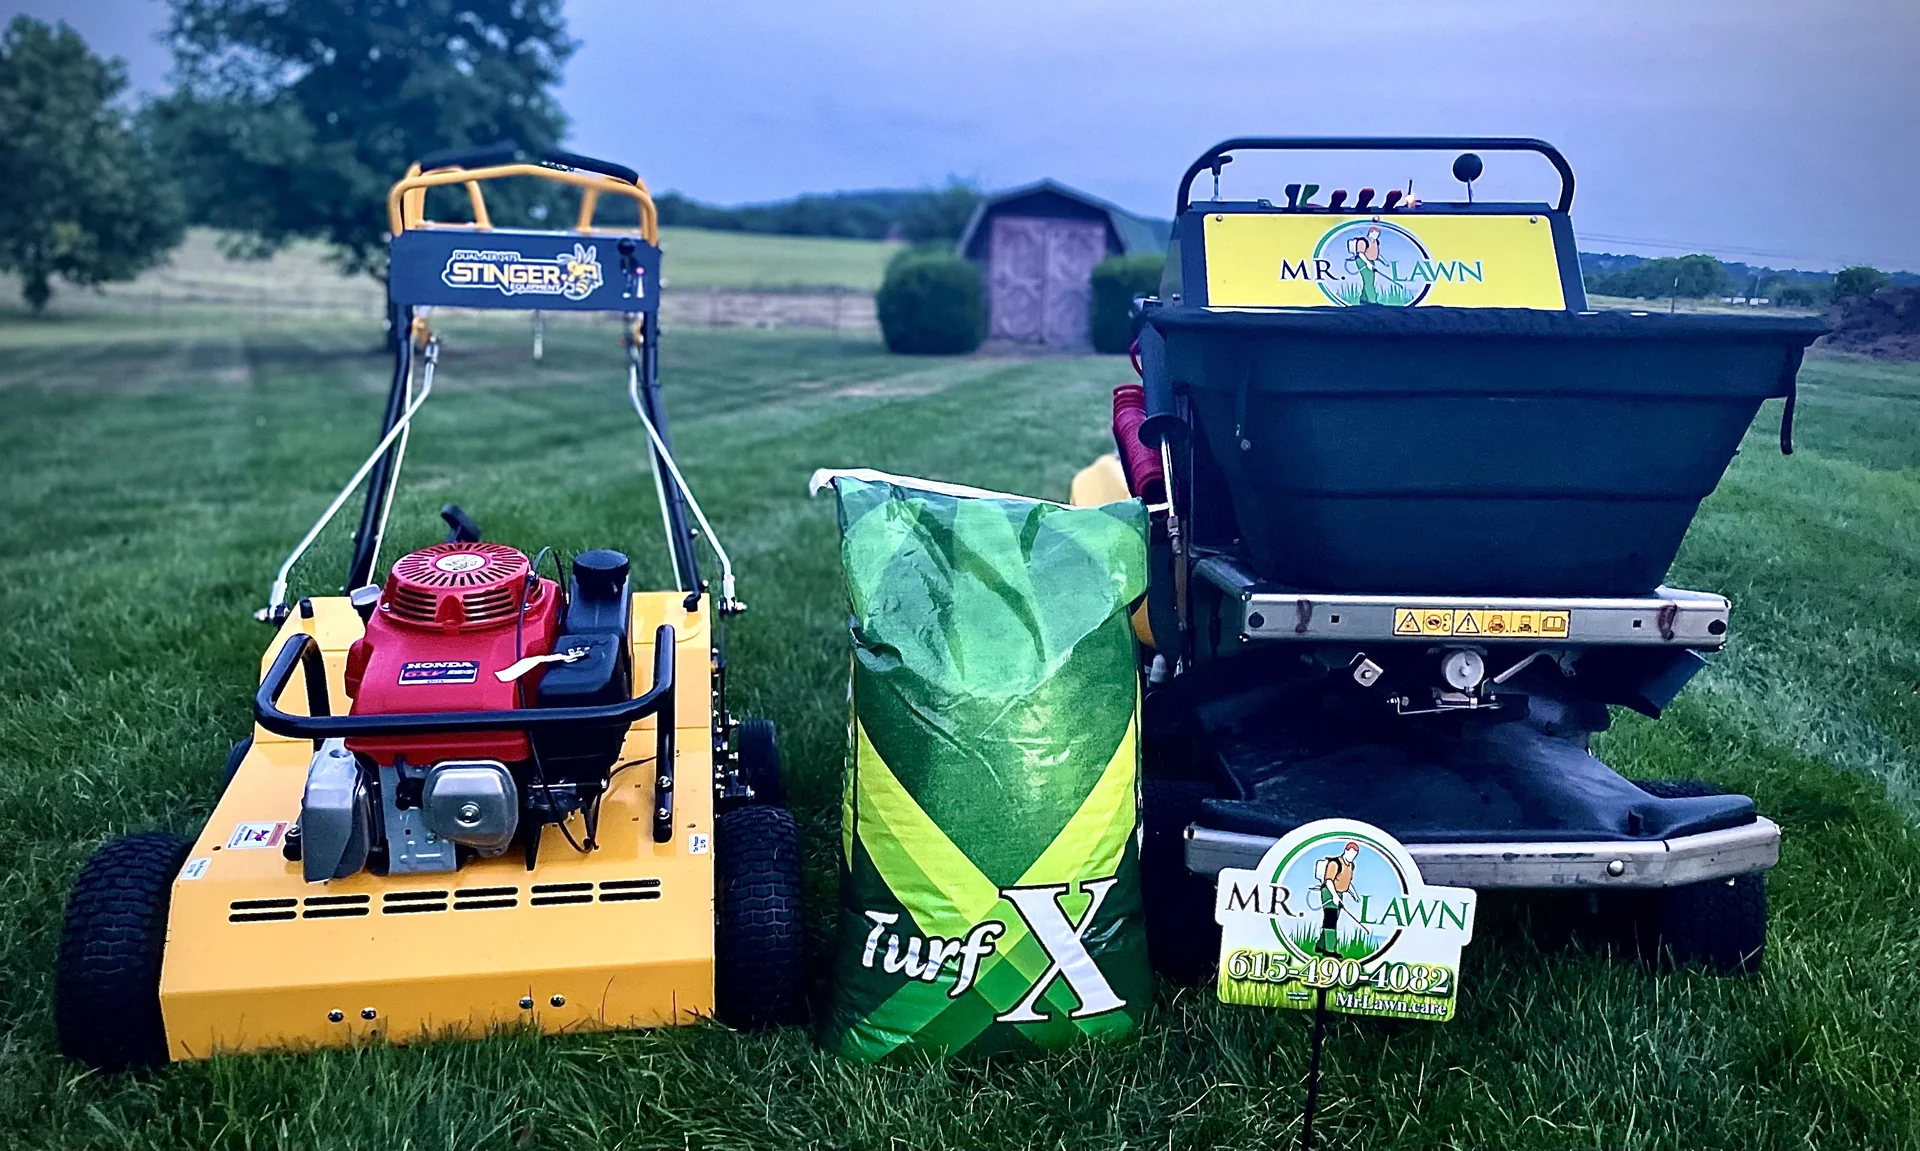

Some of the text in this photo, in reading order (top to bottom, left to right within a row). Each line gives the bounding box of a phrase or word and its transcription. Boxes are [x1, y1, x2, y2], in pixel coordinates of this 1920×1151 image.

[451, 263, 560, 290] STINGER
[1280, 258, 1484, 283] MR. LAWN
[406, 661, 473, 669] HONDA
[1225, 881, 1470, 931] MR. LAWN
[863, 878, 1127, 1022] Turf X
[1228, 950, 1449, 994] 615-490-4082
[1335, 992, 1447, 1015] MrLawn.care
